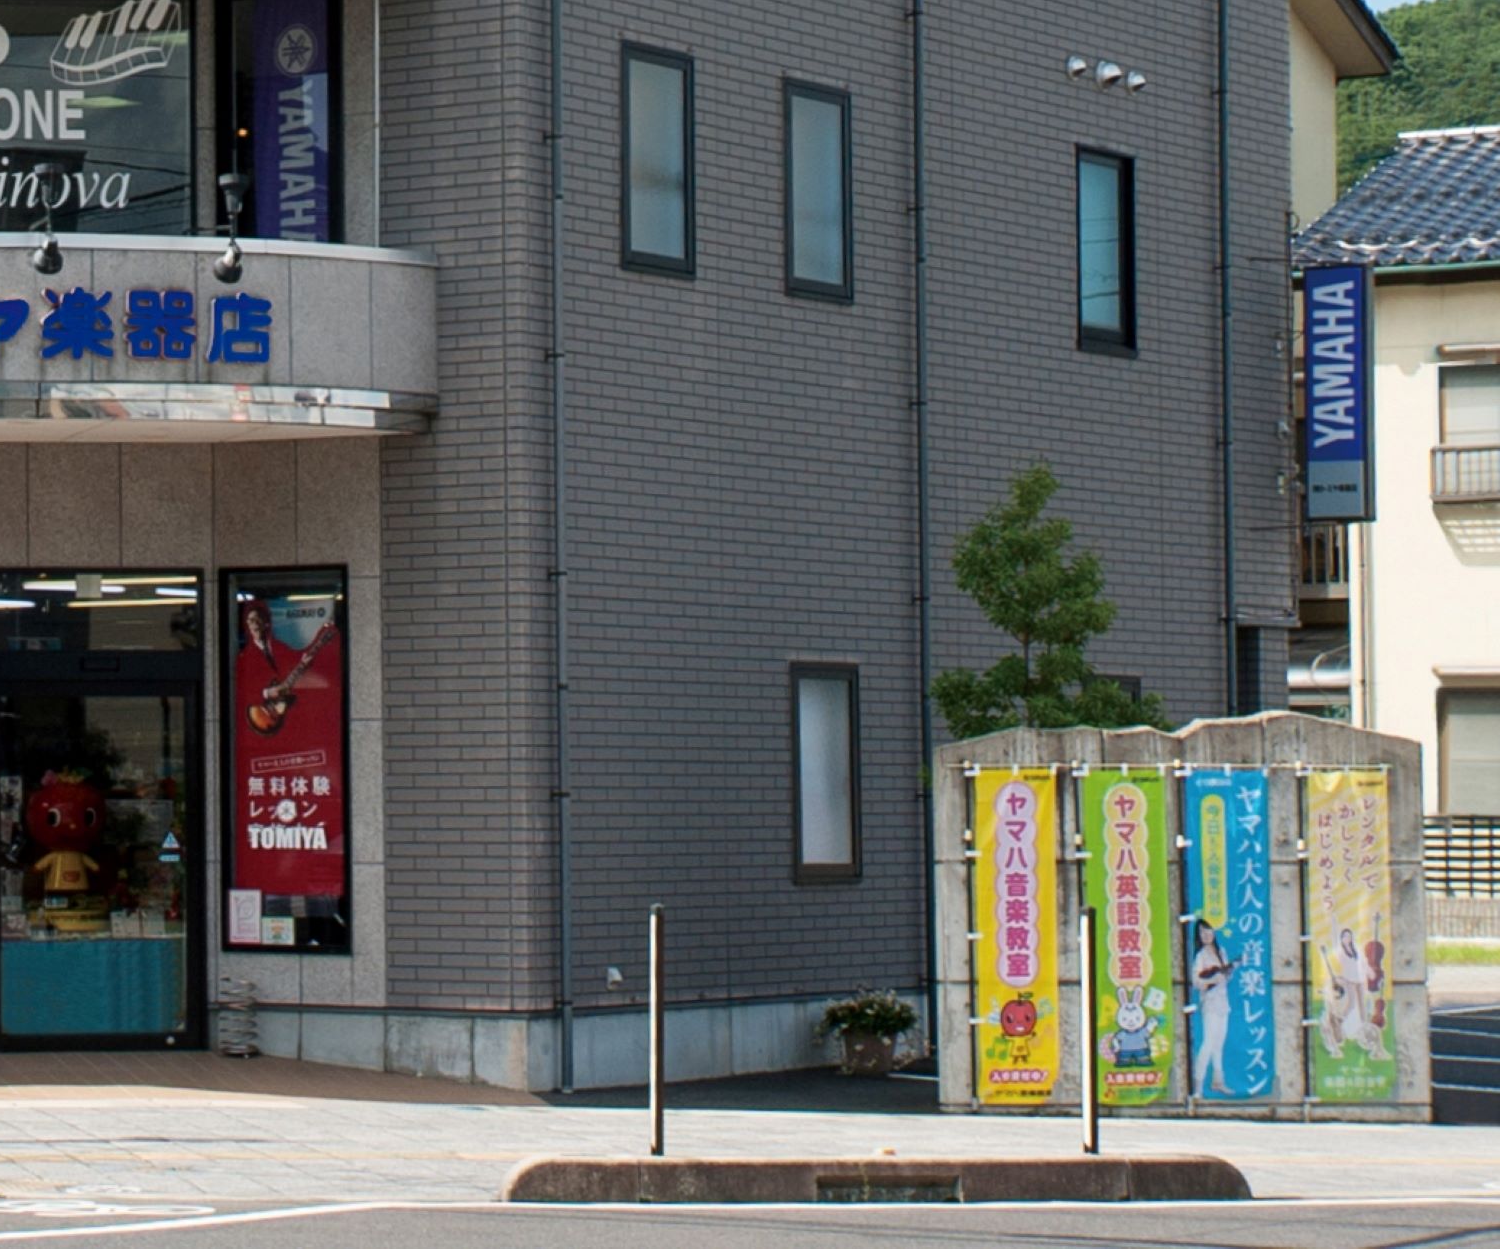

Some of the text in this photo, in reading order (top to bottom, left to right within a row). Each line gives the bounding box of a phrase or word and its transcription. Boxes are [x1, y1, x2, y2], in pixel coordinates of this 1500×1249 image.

[1312, 280, 1355, 448] YAMAHA
[248, 775, 331, 797] 無料体験
[250, 800, 318, 819] レッン
[249, 824, 328, 850] TOMIYA
[1004, 792, 1031, 978] ヤマハ音楽教室
[1317, 813, 1335, 912] はじめよう
[1338, 804, 1356, 883] かしこく
[1359, 797, 1379, 890] レンタルで
[1113, 794, 1143, 980] ヤマハ英語教室
[1235, 785, 1269, 1095] ヤマハ大人の音楽レッスン
